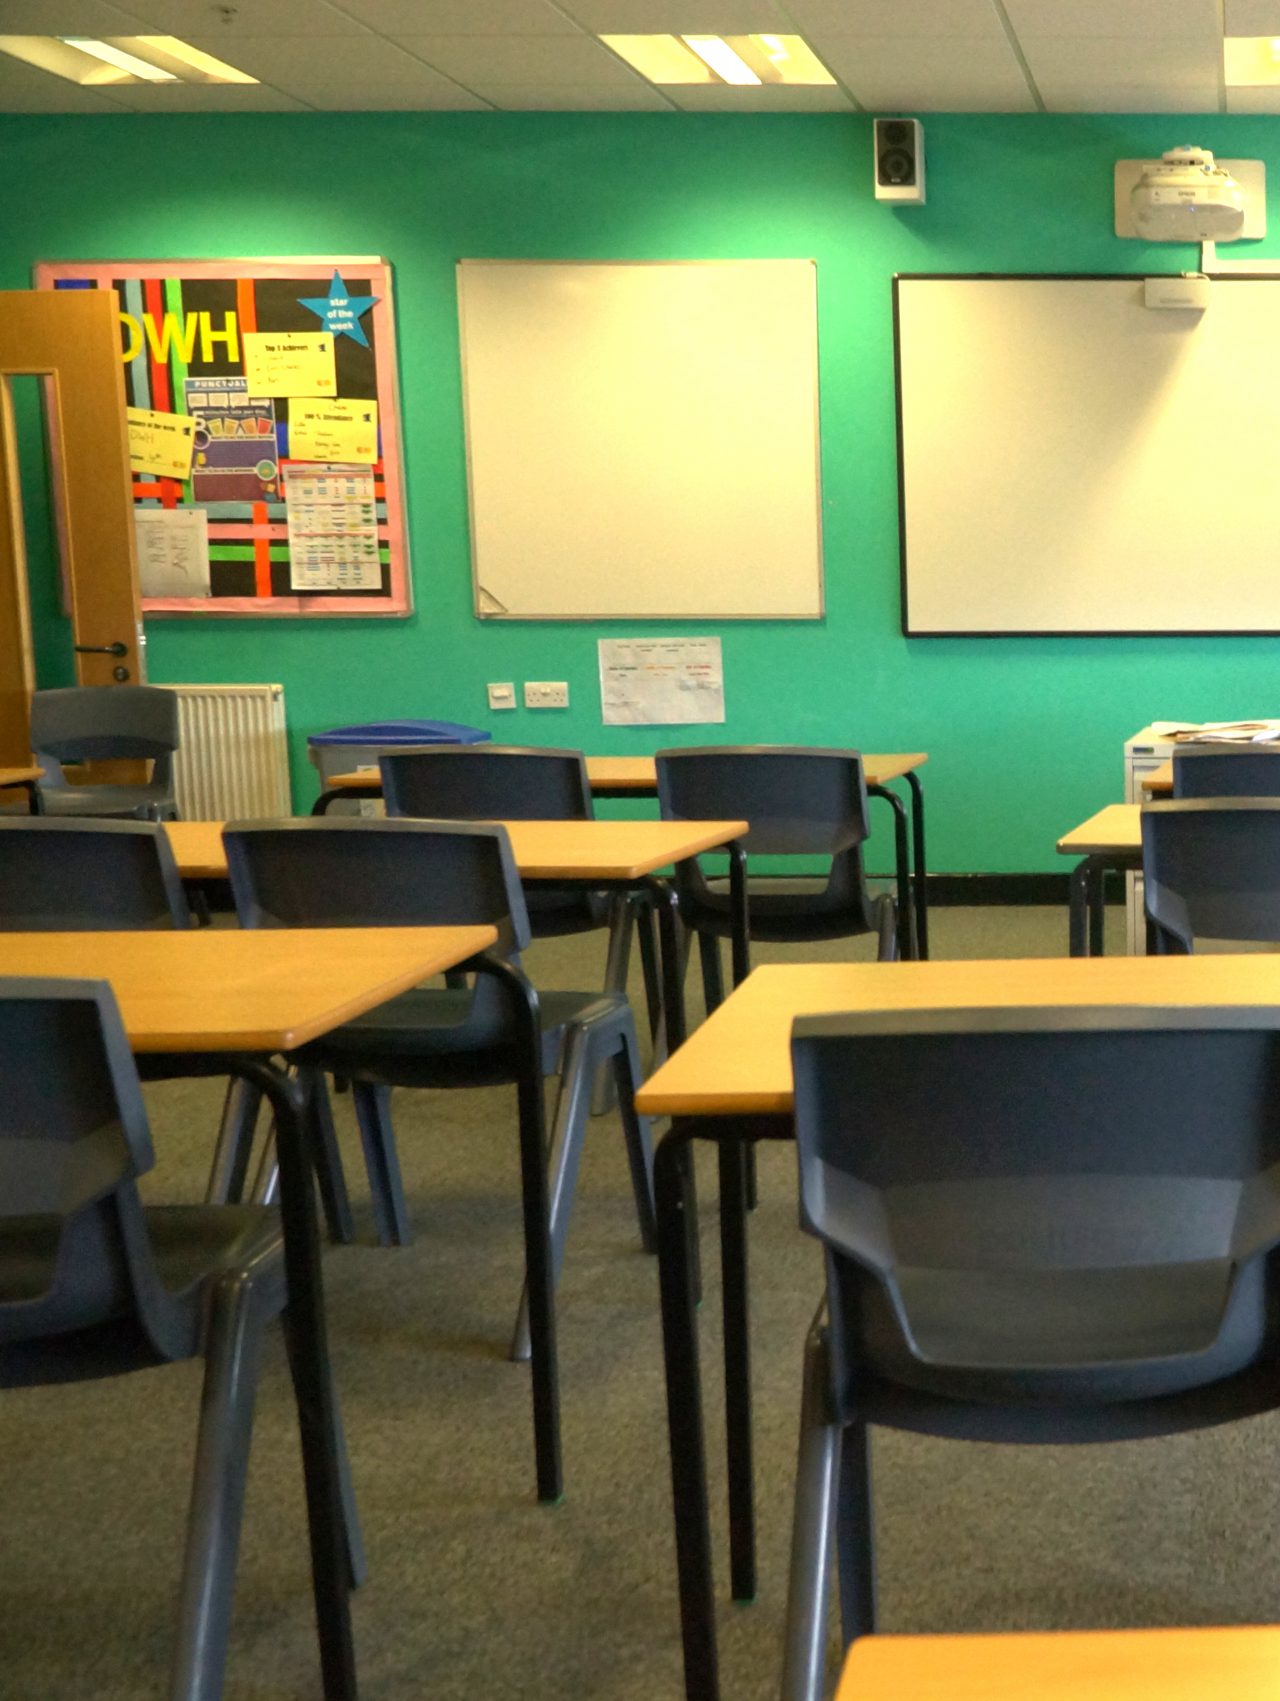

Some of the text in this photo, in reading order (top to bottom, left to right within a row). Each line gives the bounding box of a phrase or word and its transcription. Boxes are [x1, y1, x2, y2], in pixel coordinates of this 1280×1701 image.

[327, 310, 353, 318] of the
[328, 322, 354, 330] week
